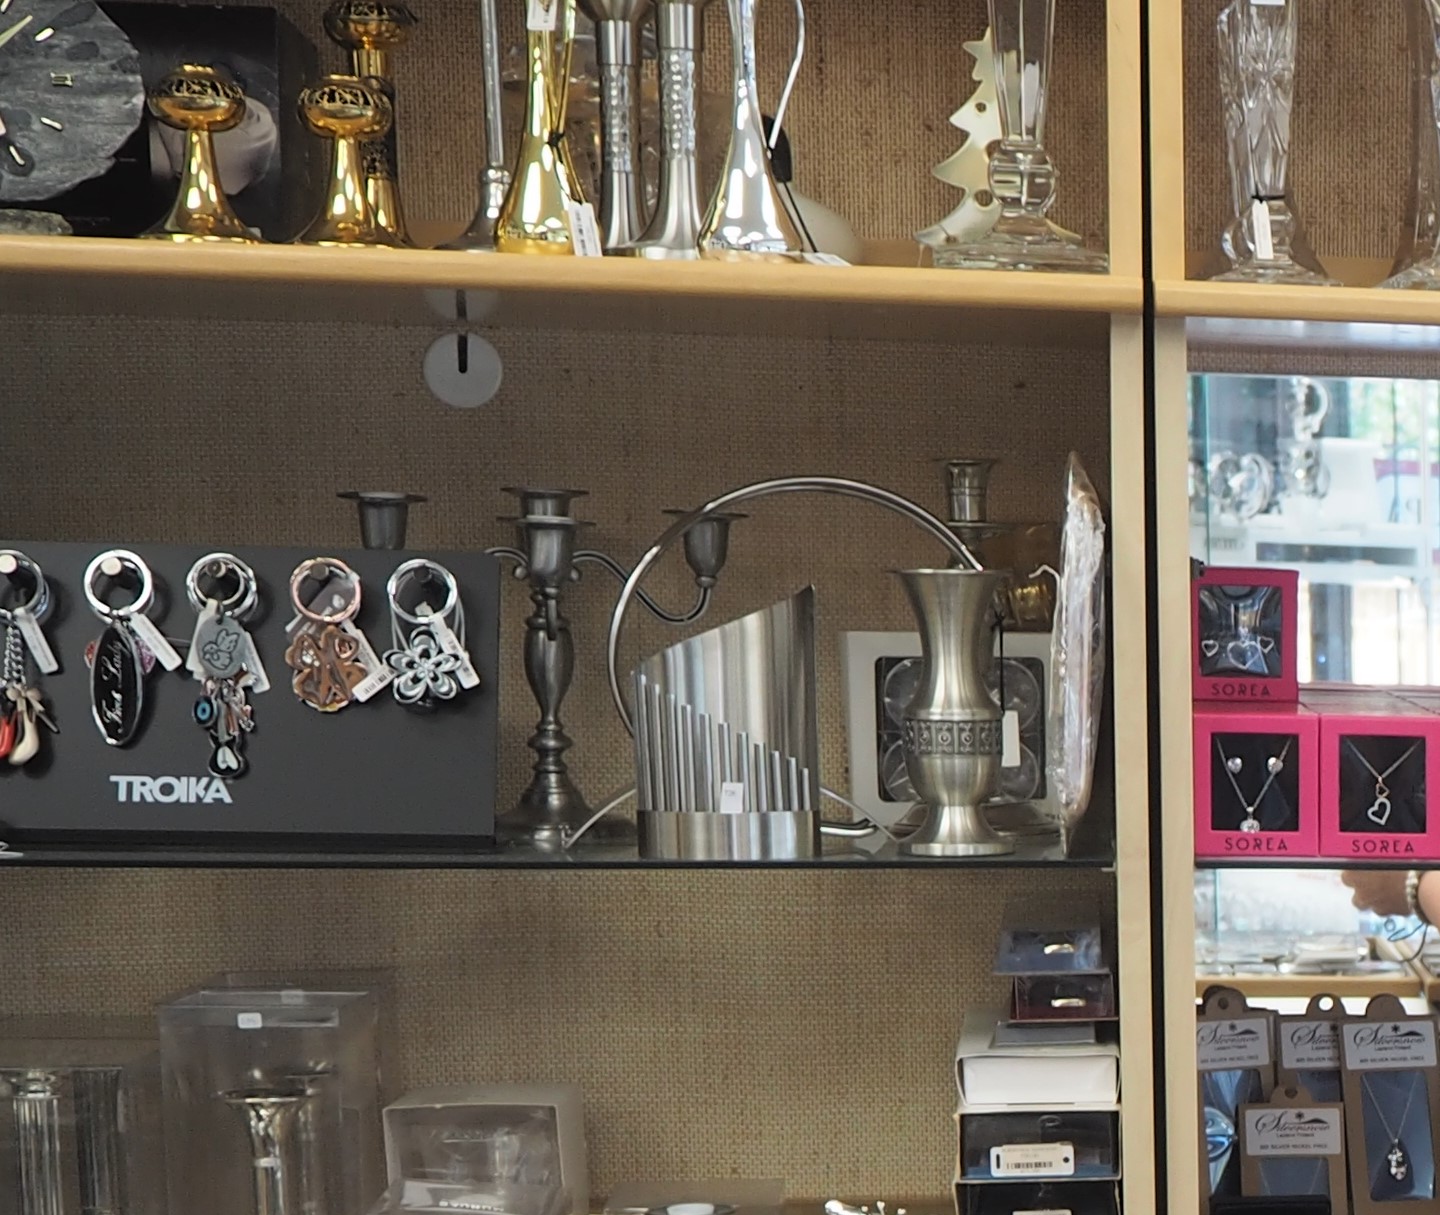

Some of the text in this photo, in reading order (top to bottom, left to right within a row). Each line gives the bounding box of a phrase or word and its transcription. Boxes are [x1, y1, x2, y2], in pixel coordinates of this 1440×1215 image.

[1211, 683, 1271, 696] SOREA
[109, 775, 233, 803] TROIKA
[1224, 837, 1288, 852] SOREA
[1352, 839, 1415, 853] SOREA
